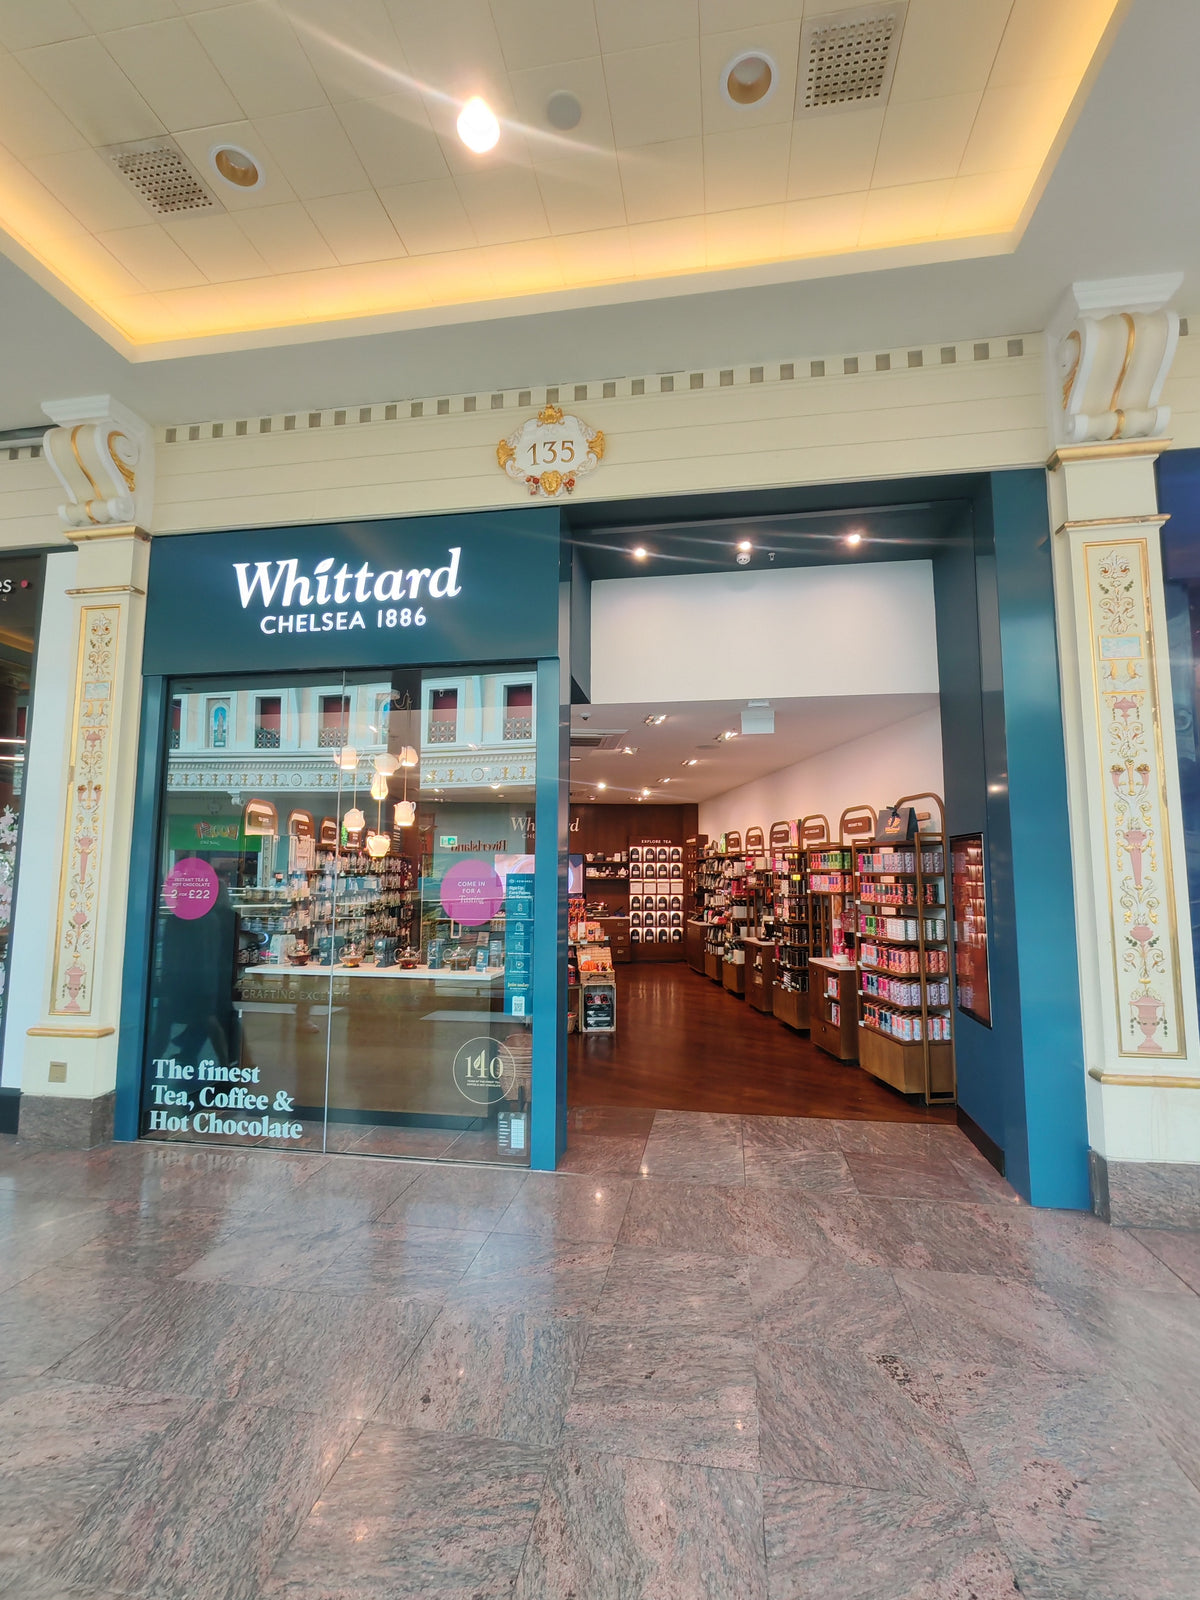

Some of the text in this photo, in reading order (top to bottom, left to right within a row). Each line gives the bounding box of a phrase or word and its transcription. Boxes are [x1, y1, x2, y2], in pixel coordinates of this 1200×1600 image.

[527, 440, 575, 466] 135
[232, 547, 462, 608] Whittard
[260, 607, 427, 634] CHELSEA 1886
[171, 890, 178, 899] 2
[189, 890, 210, 899] £22
[242, 989, 296, 1000] CRAFTING
[152, 1058, 261, 1083] The finest
[465, 1049, 504, 1079] 140
[151, 1084, 295, 1112] Tea, Coffee &
[149, 1110, 303, 1139] Hot Chocolate
